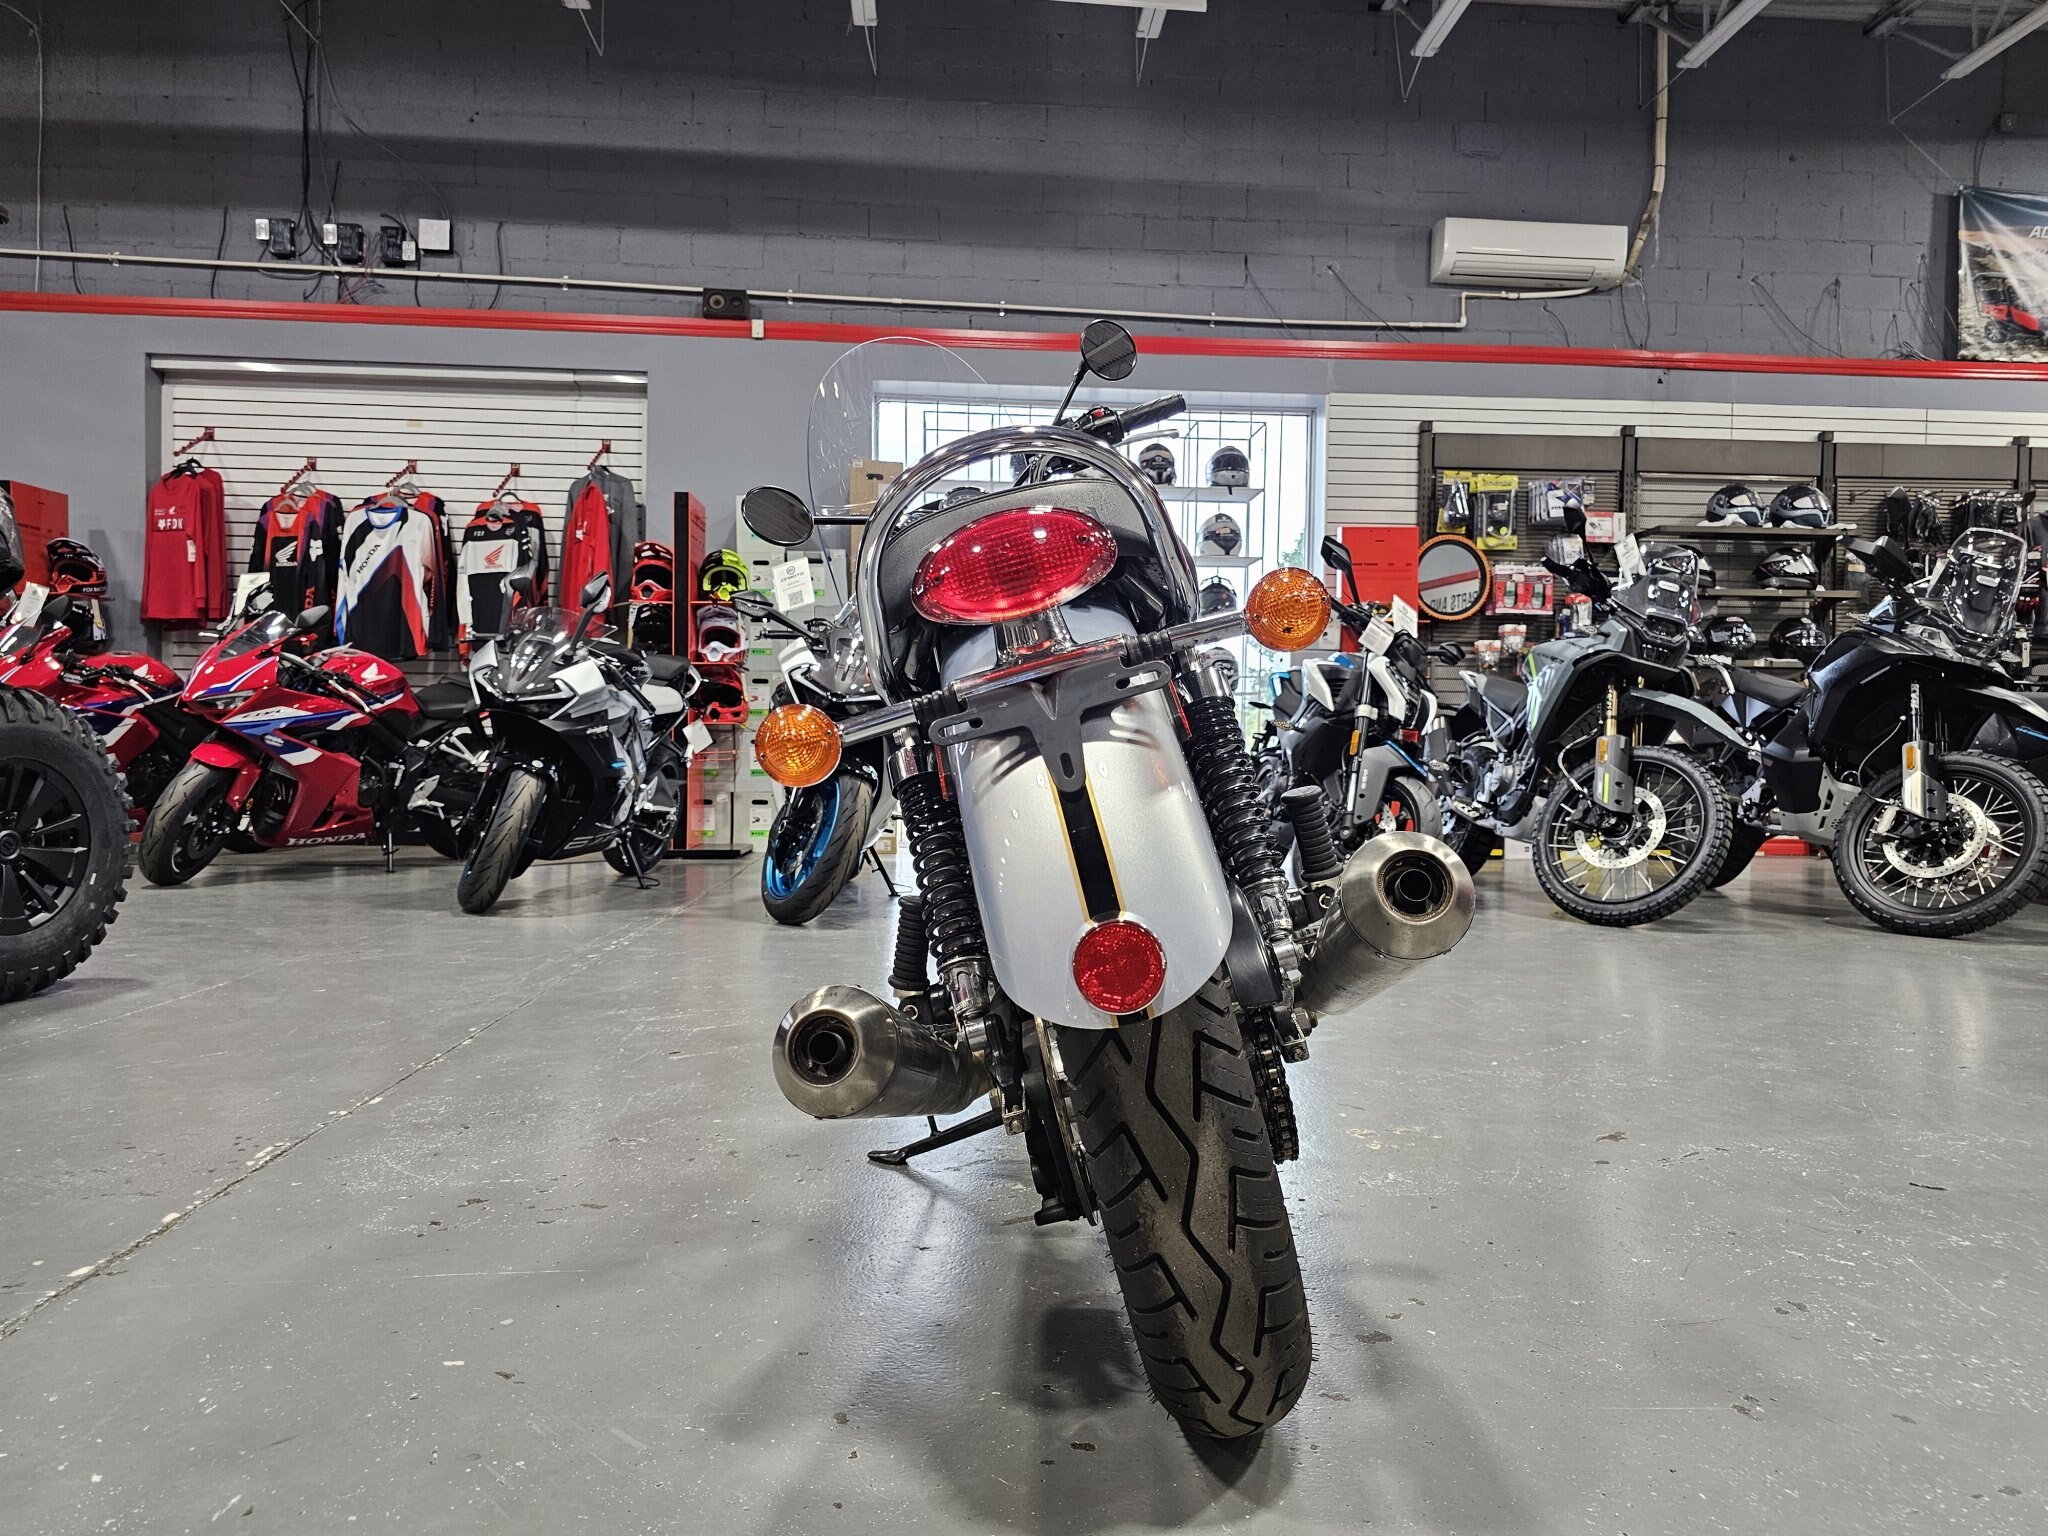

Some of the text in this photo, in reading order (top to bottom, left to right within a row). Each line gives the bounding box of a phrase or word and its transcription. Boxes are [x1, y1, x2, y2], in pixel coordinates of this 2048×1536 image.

[166, 518, 183, 530] FOX
[357, 544, 381, 574] HONDA
[286, 832, 367, 847] HONDA
